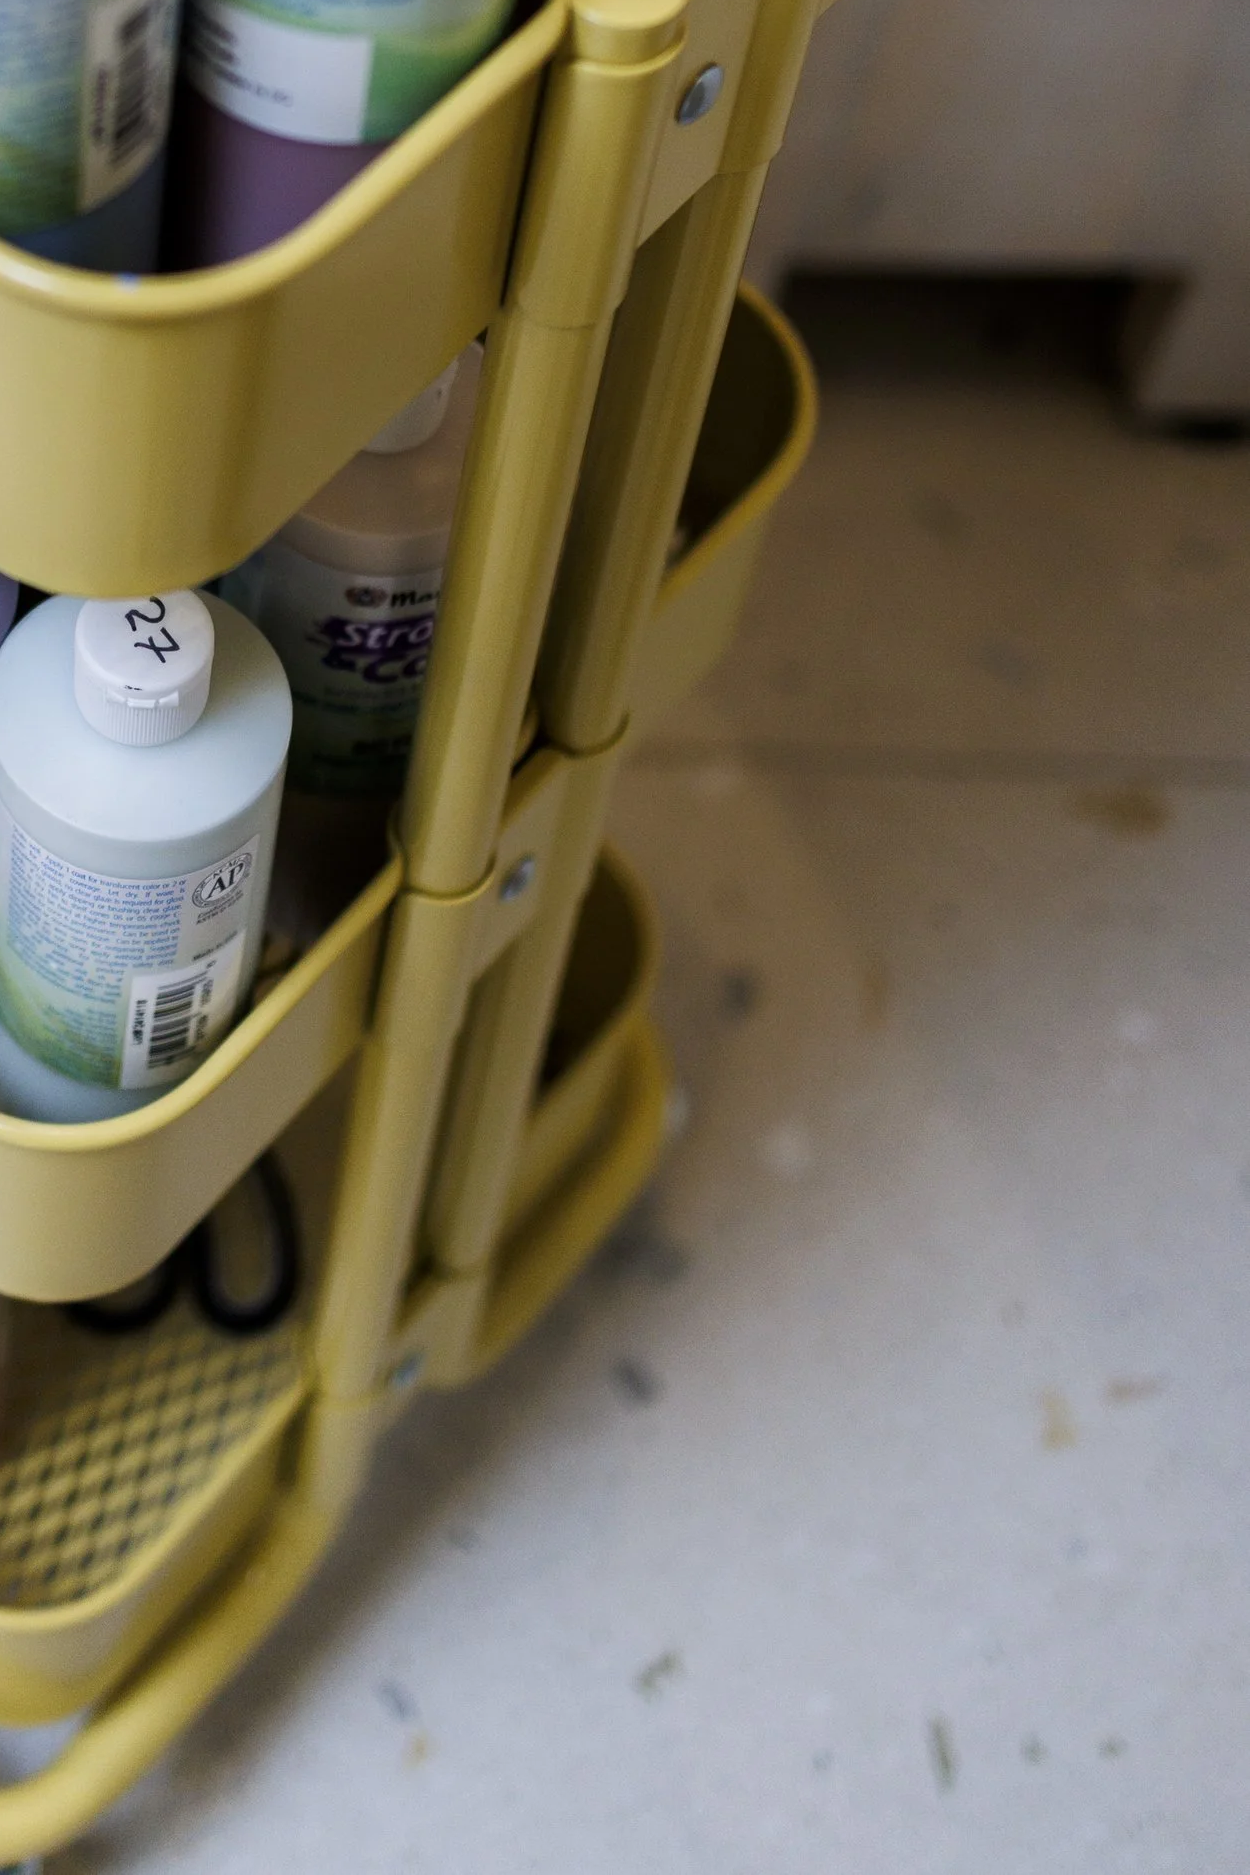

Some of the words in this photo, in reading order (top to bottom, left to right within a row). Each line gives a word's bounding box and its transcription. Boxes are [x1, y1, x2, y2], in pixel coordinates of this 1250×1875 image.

[125, 597, 181, 663] 27
[336, 621, 434, 650] Stro
[71, 870, 86, 880] coat
[100, 879, 140, 890] translucent
[205, 862, 244, 901] AP
